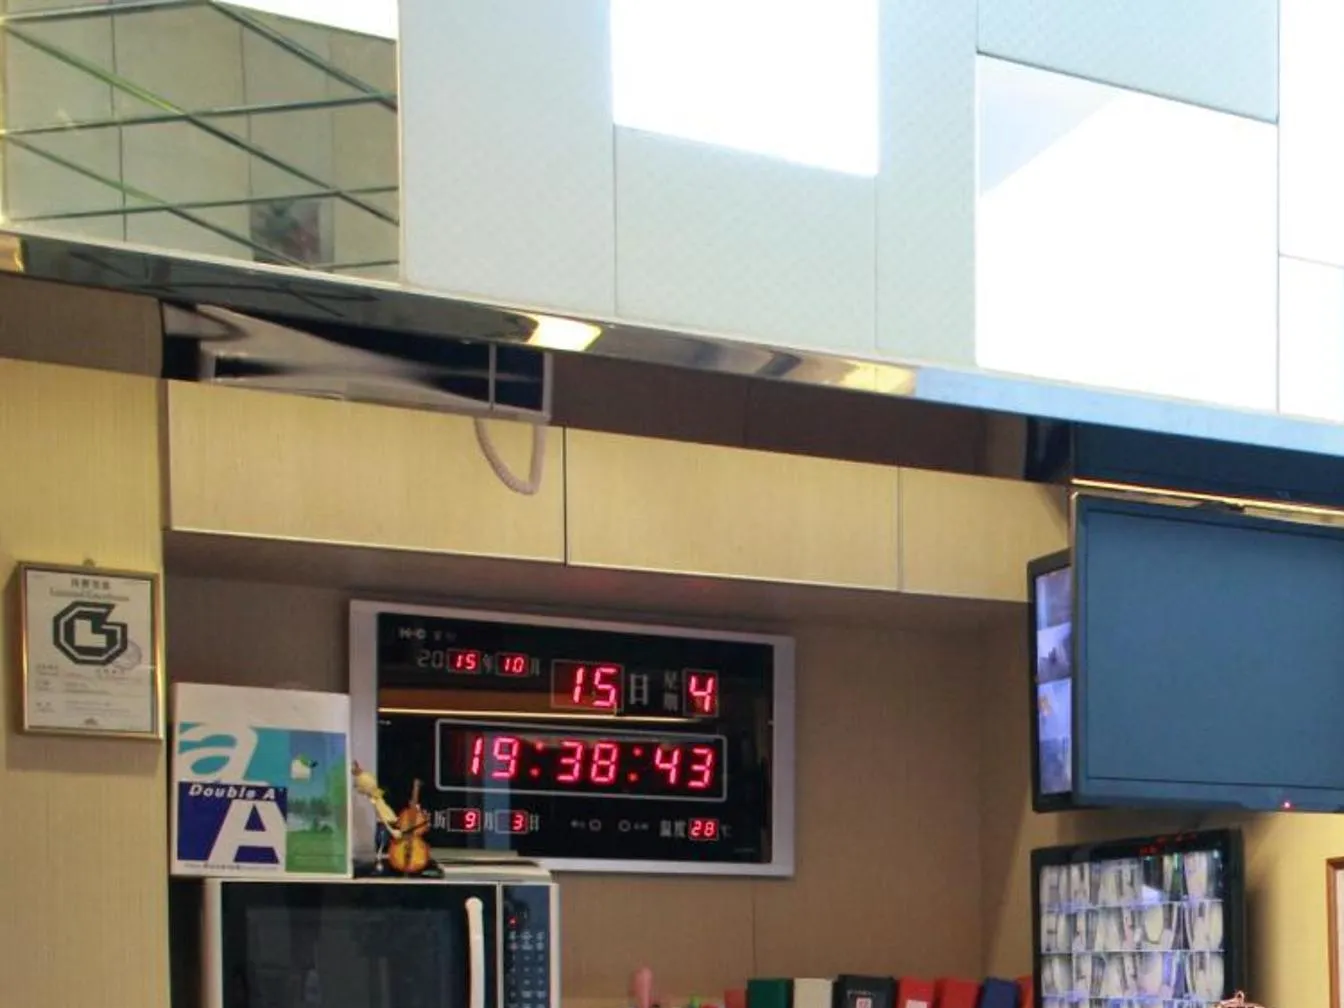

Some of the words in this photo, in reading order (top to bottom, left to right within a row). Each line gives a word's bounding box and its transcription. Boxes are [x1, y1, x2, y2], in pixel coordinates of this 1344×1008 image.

[456, 652, 477, 670] 15
[503, 656, 525, 673] 10
[573, 666, 618, 708] 15
[630, 673, 648, 706] 日
[689, 675, 714, 712] 4
[469, 736, 715, 789] 19:38:43
[188, 784, 257, 799] Double
[263, 789, 277, 800] A
[465, 811, 477, 829] 9
[512, 814, 524, 831] 3
[691, 820, 715, 837] 28
